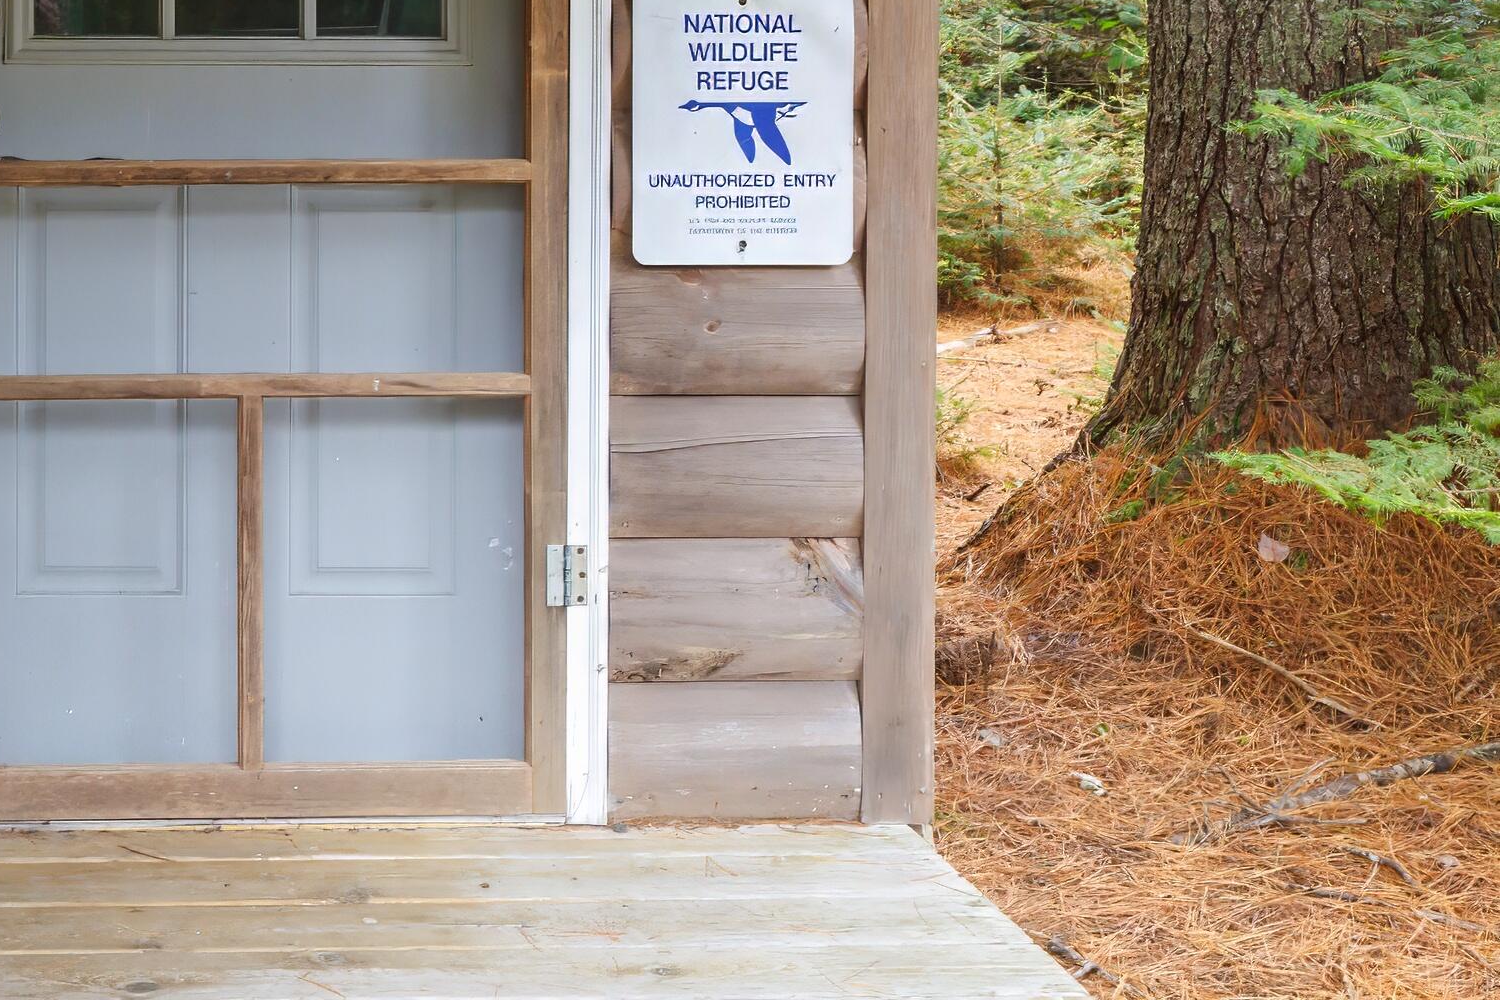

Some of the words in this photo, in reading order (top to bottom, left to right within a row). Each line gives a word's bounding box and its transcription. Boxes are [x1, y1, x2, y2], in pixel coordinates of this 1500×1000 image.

[684, 13, 802, 34] NATIONAL
[688, 42, 798, 62] WILDLIFE
[696, 71, 789, 91] REFUGE
[649, 174, 775, 188] UNAUTHORIZED
[783, 174, 837, 188] ENTRY
[695, 195, 791, 209] PROHIBITED
